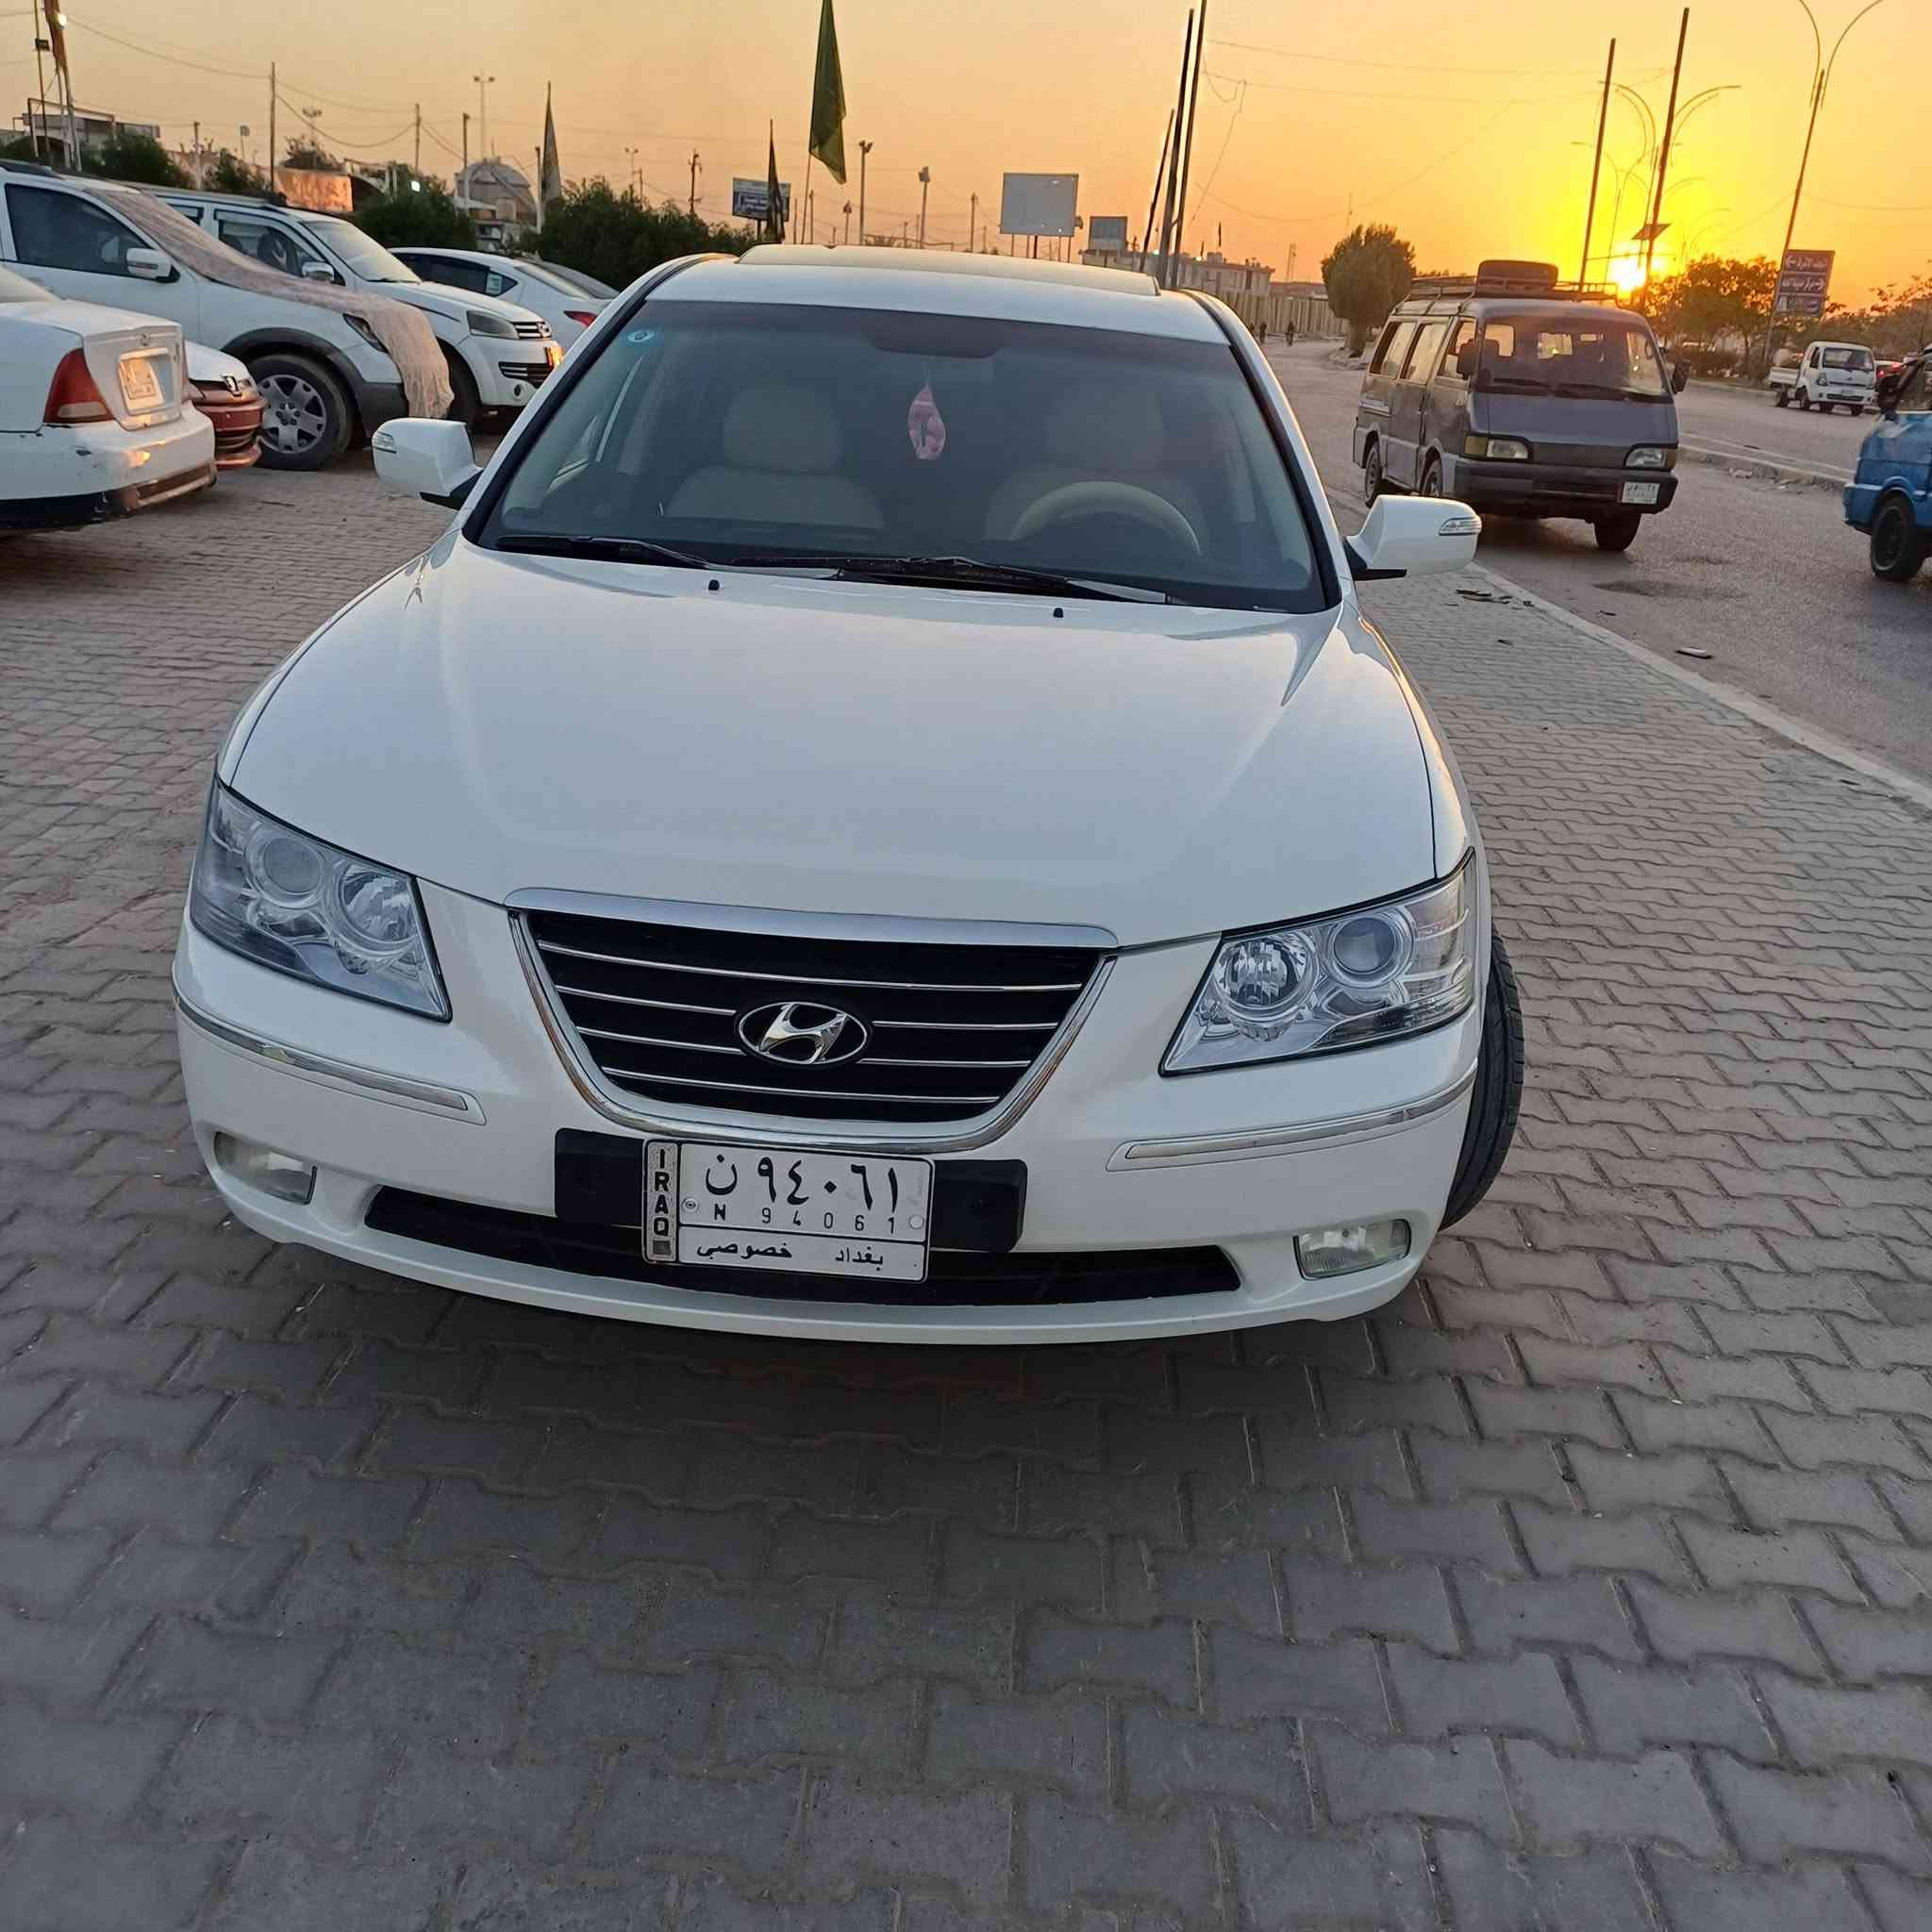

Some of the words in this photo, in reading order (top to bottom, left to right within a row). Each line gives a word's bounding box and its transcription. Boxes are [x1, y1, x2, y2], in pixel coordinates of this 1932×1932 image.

[654, 1148, 670, 1237] IRAQ
[696, 1242, 792, 1260] خصوصي
[835, 1246, 884, 1271] بغداد
